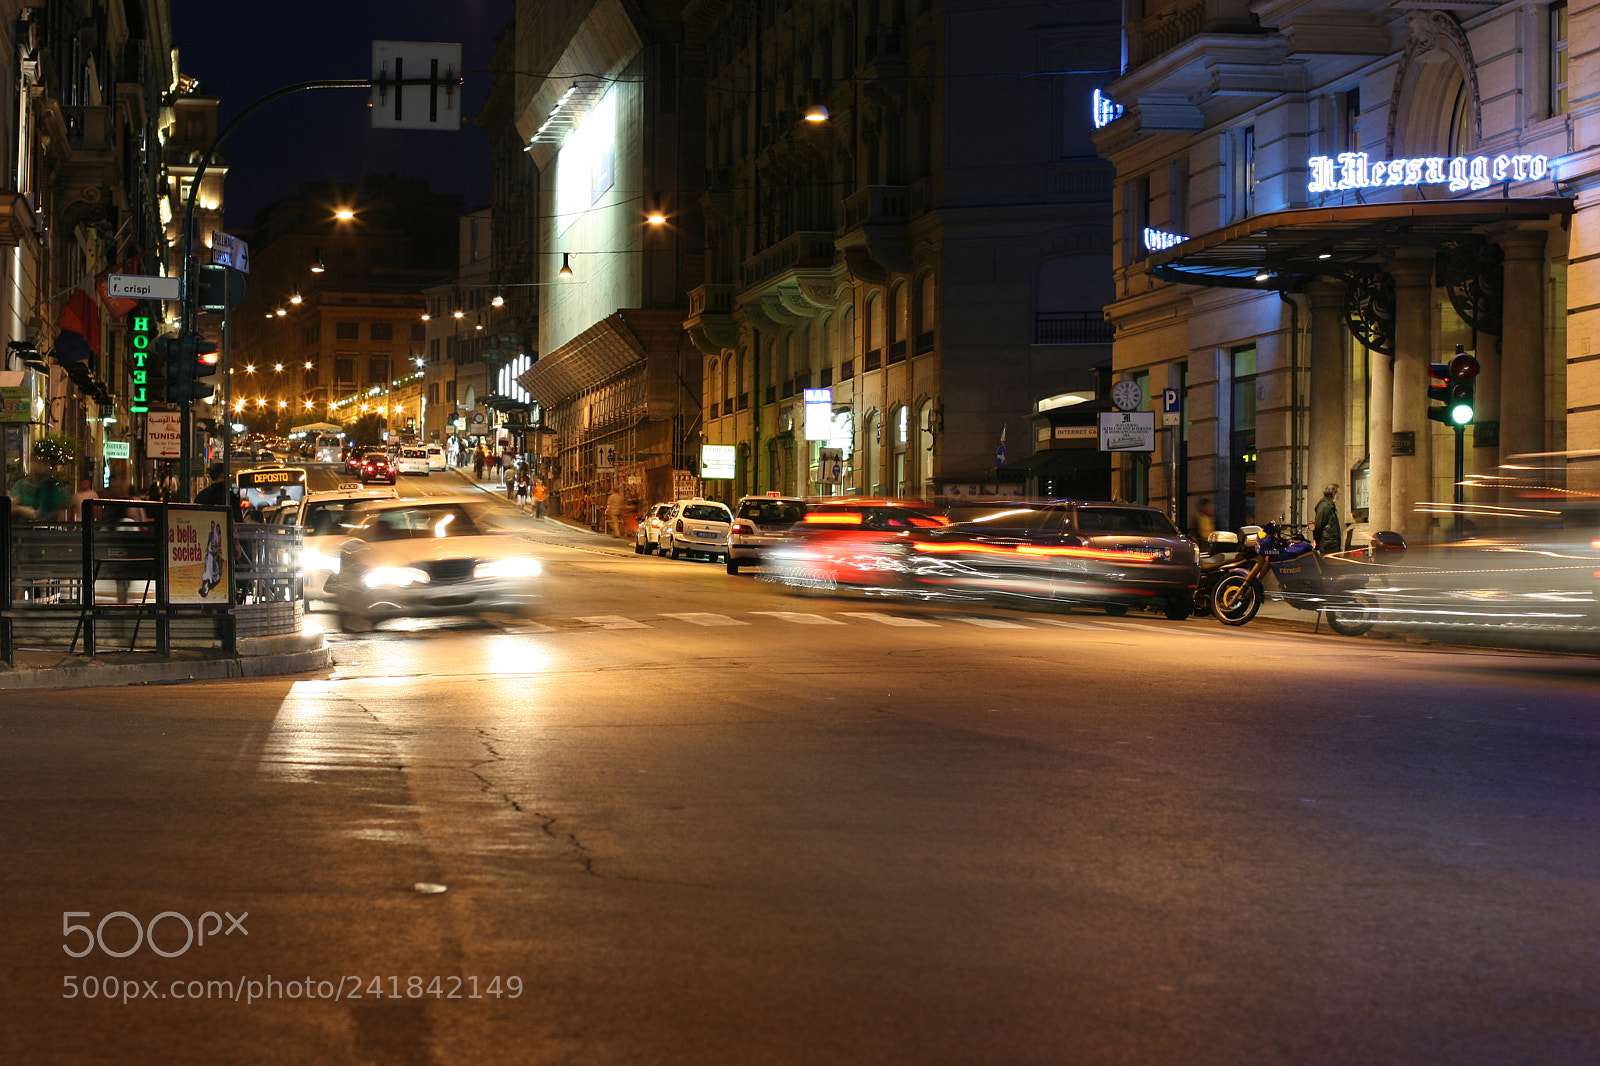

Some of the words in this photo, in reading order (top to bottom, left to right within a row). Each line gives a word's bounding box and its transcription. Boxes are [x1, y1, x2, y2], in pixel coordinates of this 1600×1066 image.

[1338, 152, 1547, 192] Messaggero
[113, 284, 120, 292] f.
[124, 285, 151, 295] crispi
[805, 389, 831, 402] BAR
[1166, 390, 1177, 411] P
[254, 473, 289, 483] DEPOSITO
[177, 524, 197, 543] bella
[172, 542, 203, 562] società
